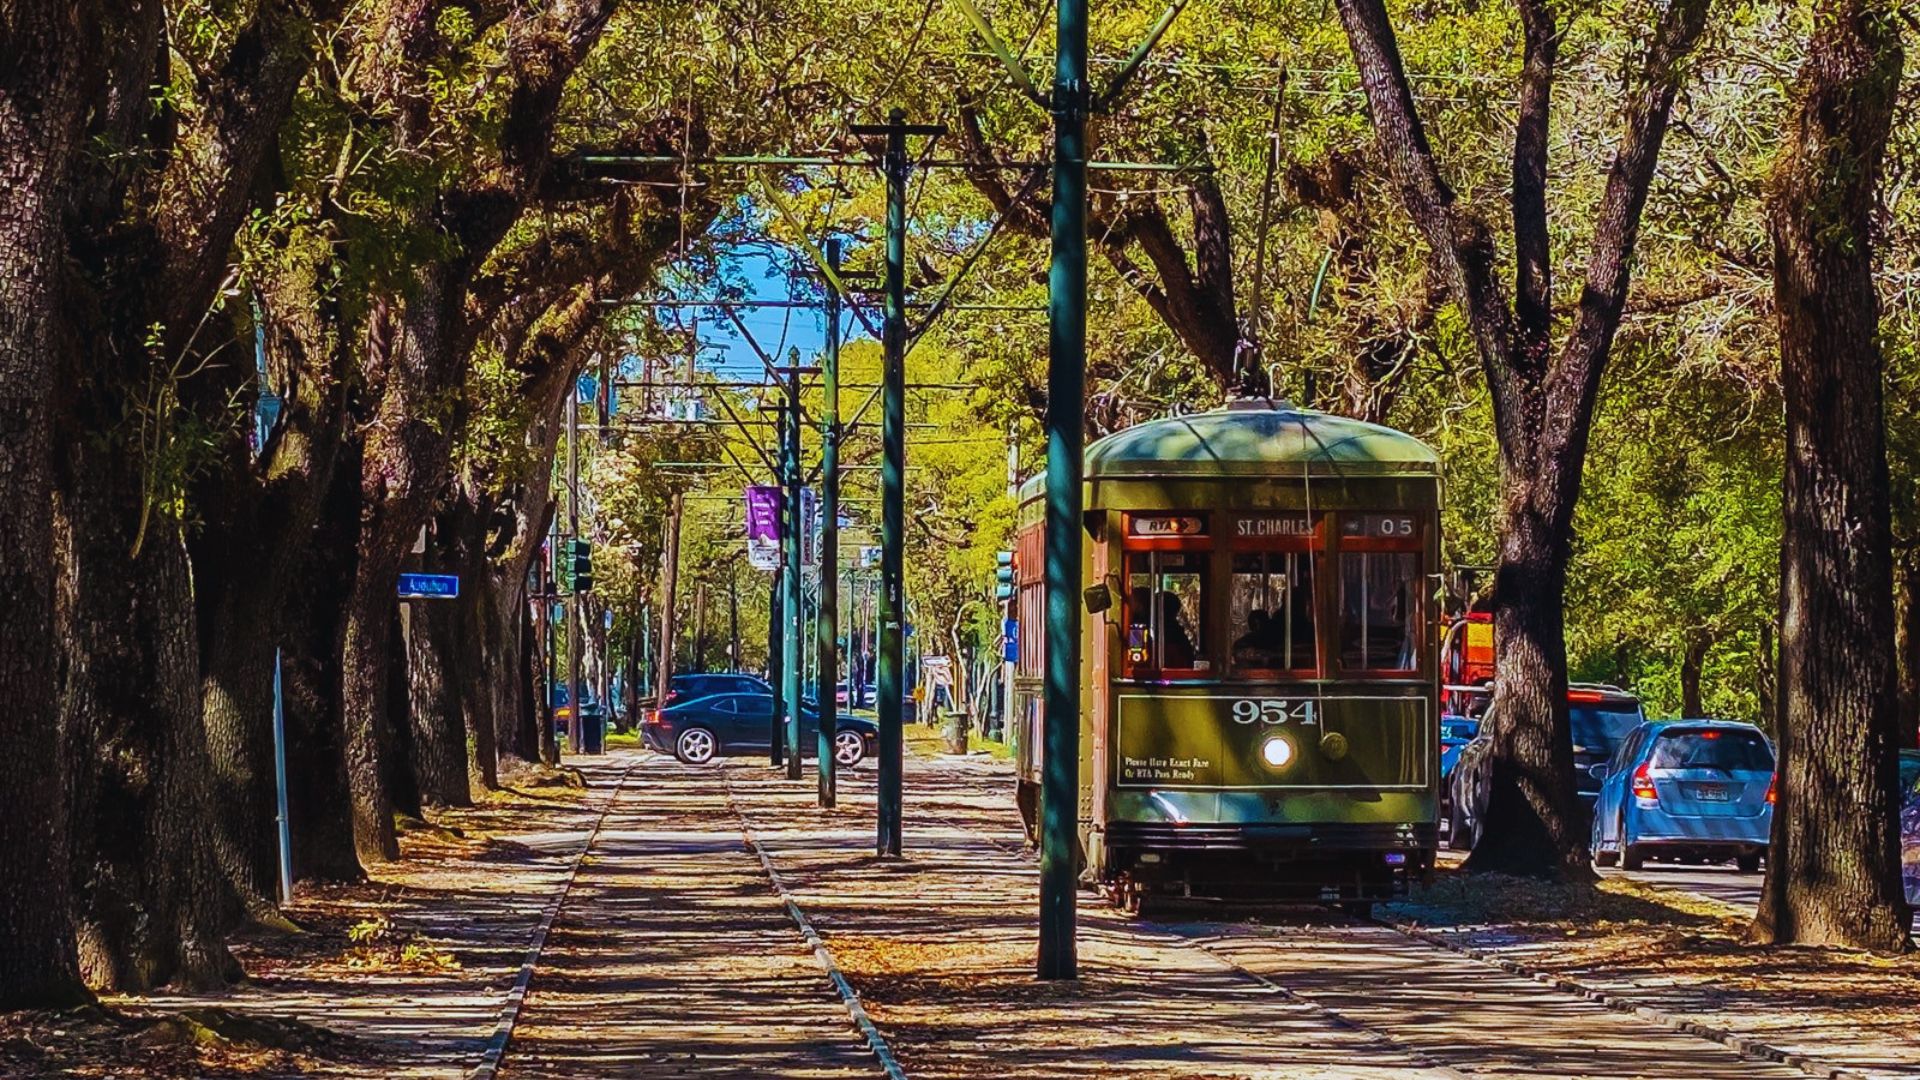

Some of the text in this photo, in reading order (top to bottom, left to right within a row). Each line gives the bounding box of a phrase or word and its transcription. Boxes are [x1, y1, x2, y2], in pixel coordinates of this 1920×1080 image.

[1149, 520, 1172, 531] RTA
[1237, 519, 1314, 536] ST. CHARLES
[1232, 700, 1317, 725] 954
[1125, 757, 1209, 768] Please Have Exact Fare
[1136, 769, 1152, 778] RTA
[1154, 769, 1171, 778] Pass
[1172, 769, 1195, 780] Ready
